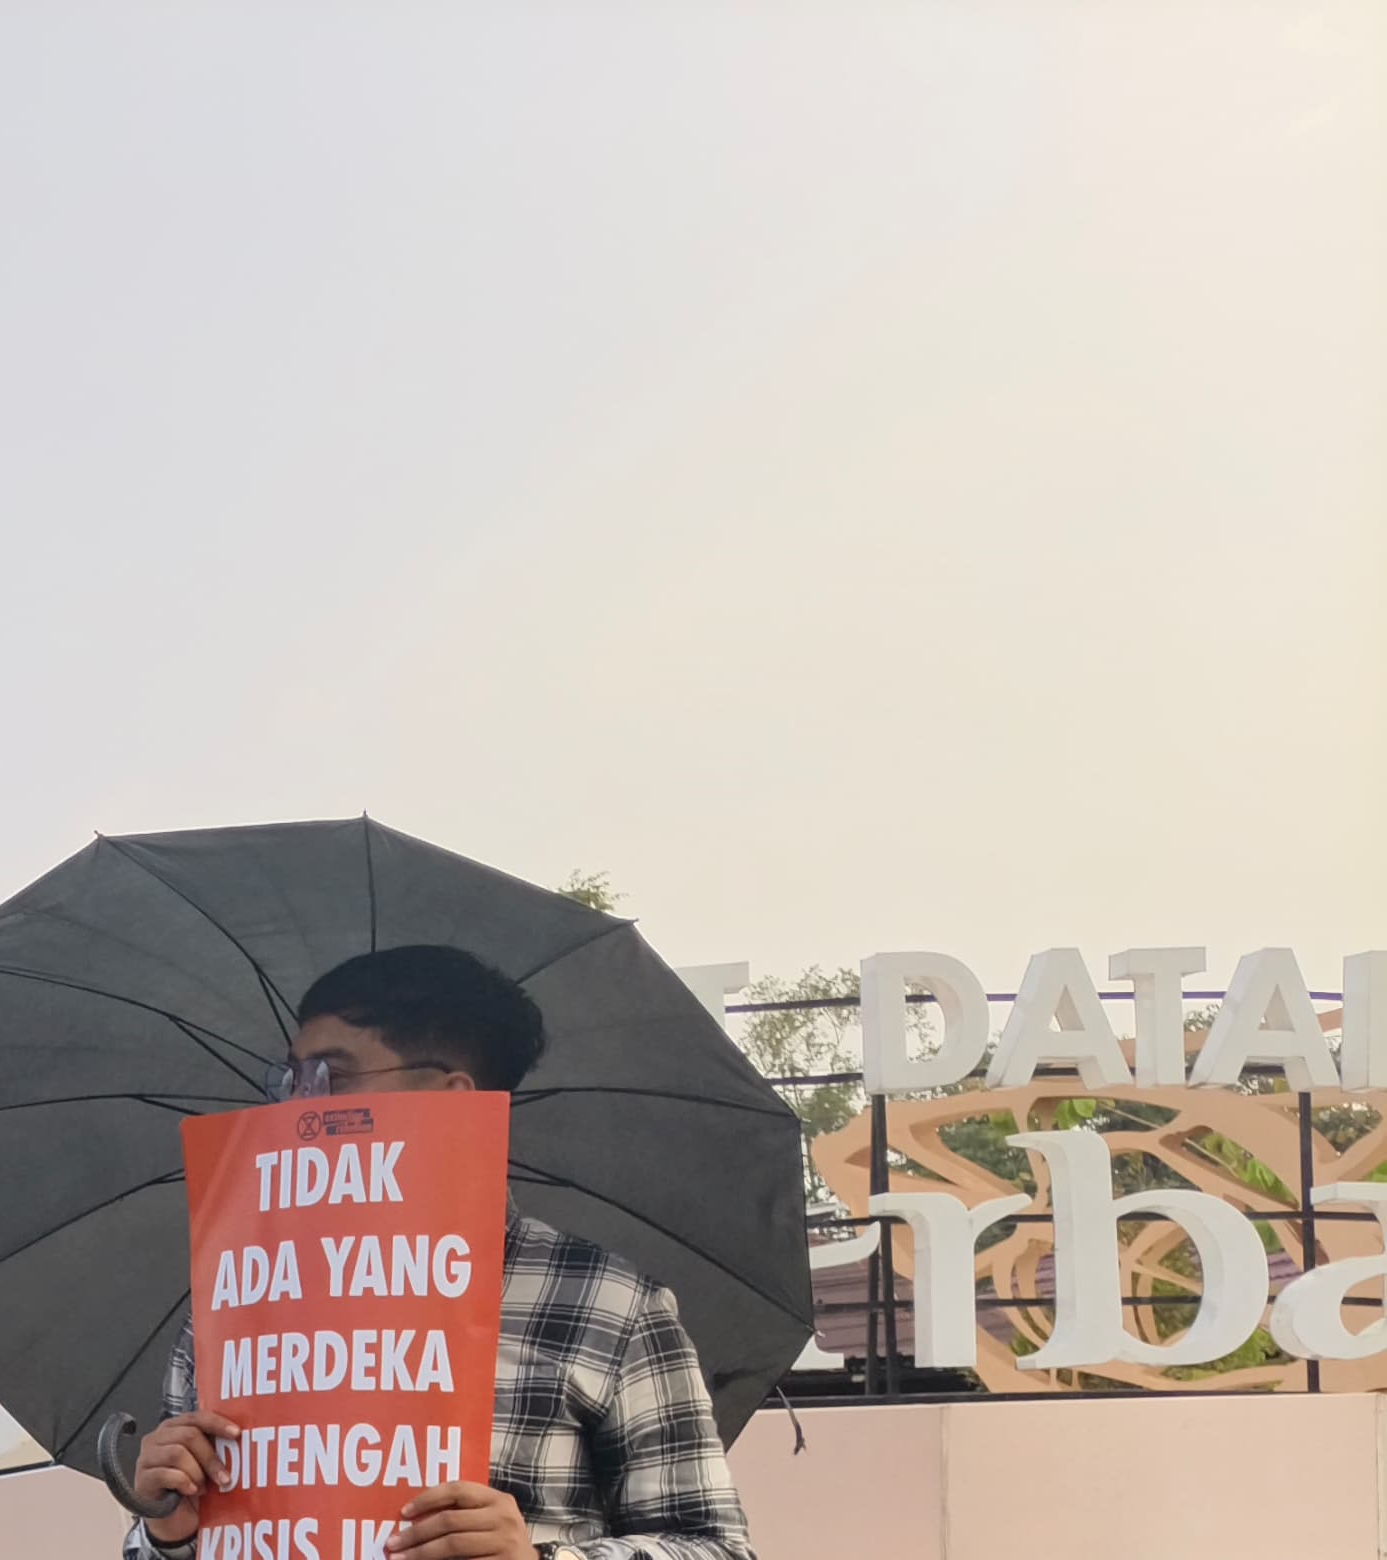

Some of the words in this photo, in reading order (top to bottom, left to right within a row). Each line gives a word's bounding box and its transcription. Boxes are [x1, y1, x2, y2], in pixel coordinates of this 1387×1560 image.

[255, 1141, 405, 1212] TIDAK
[210, 1238, 303, 1311] ADA
[320, 1234, 473, 1298] YANG
[220, 1329, 455, 1400] MERDEKA
[215, 1422, 462, 1493] DITENGAH
